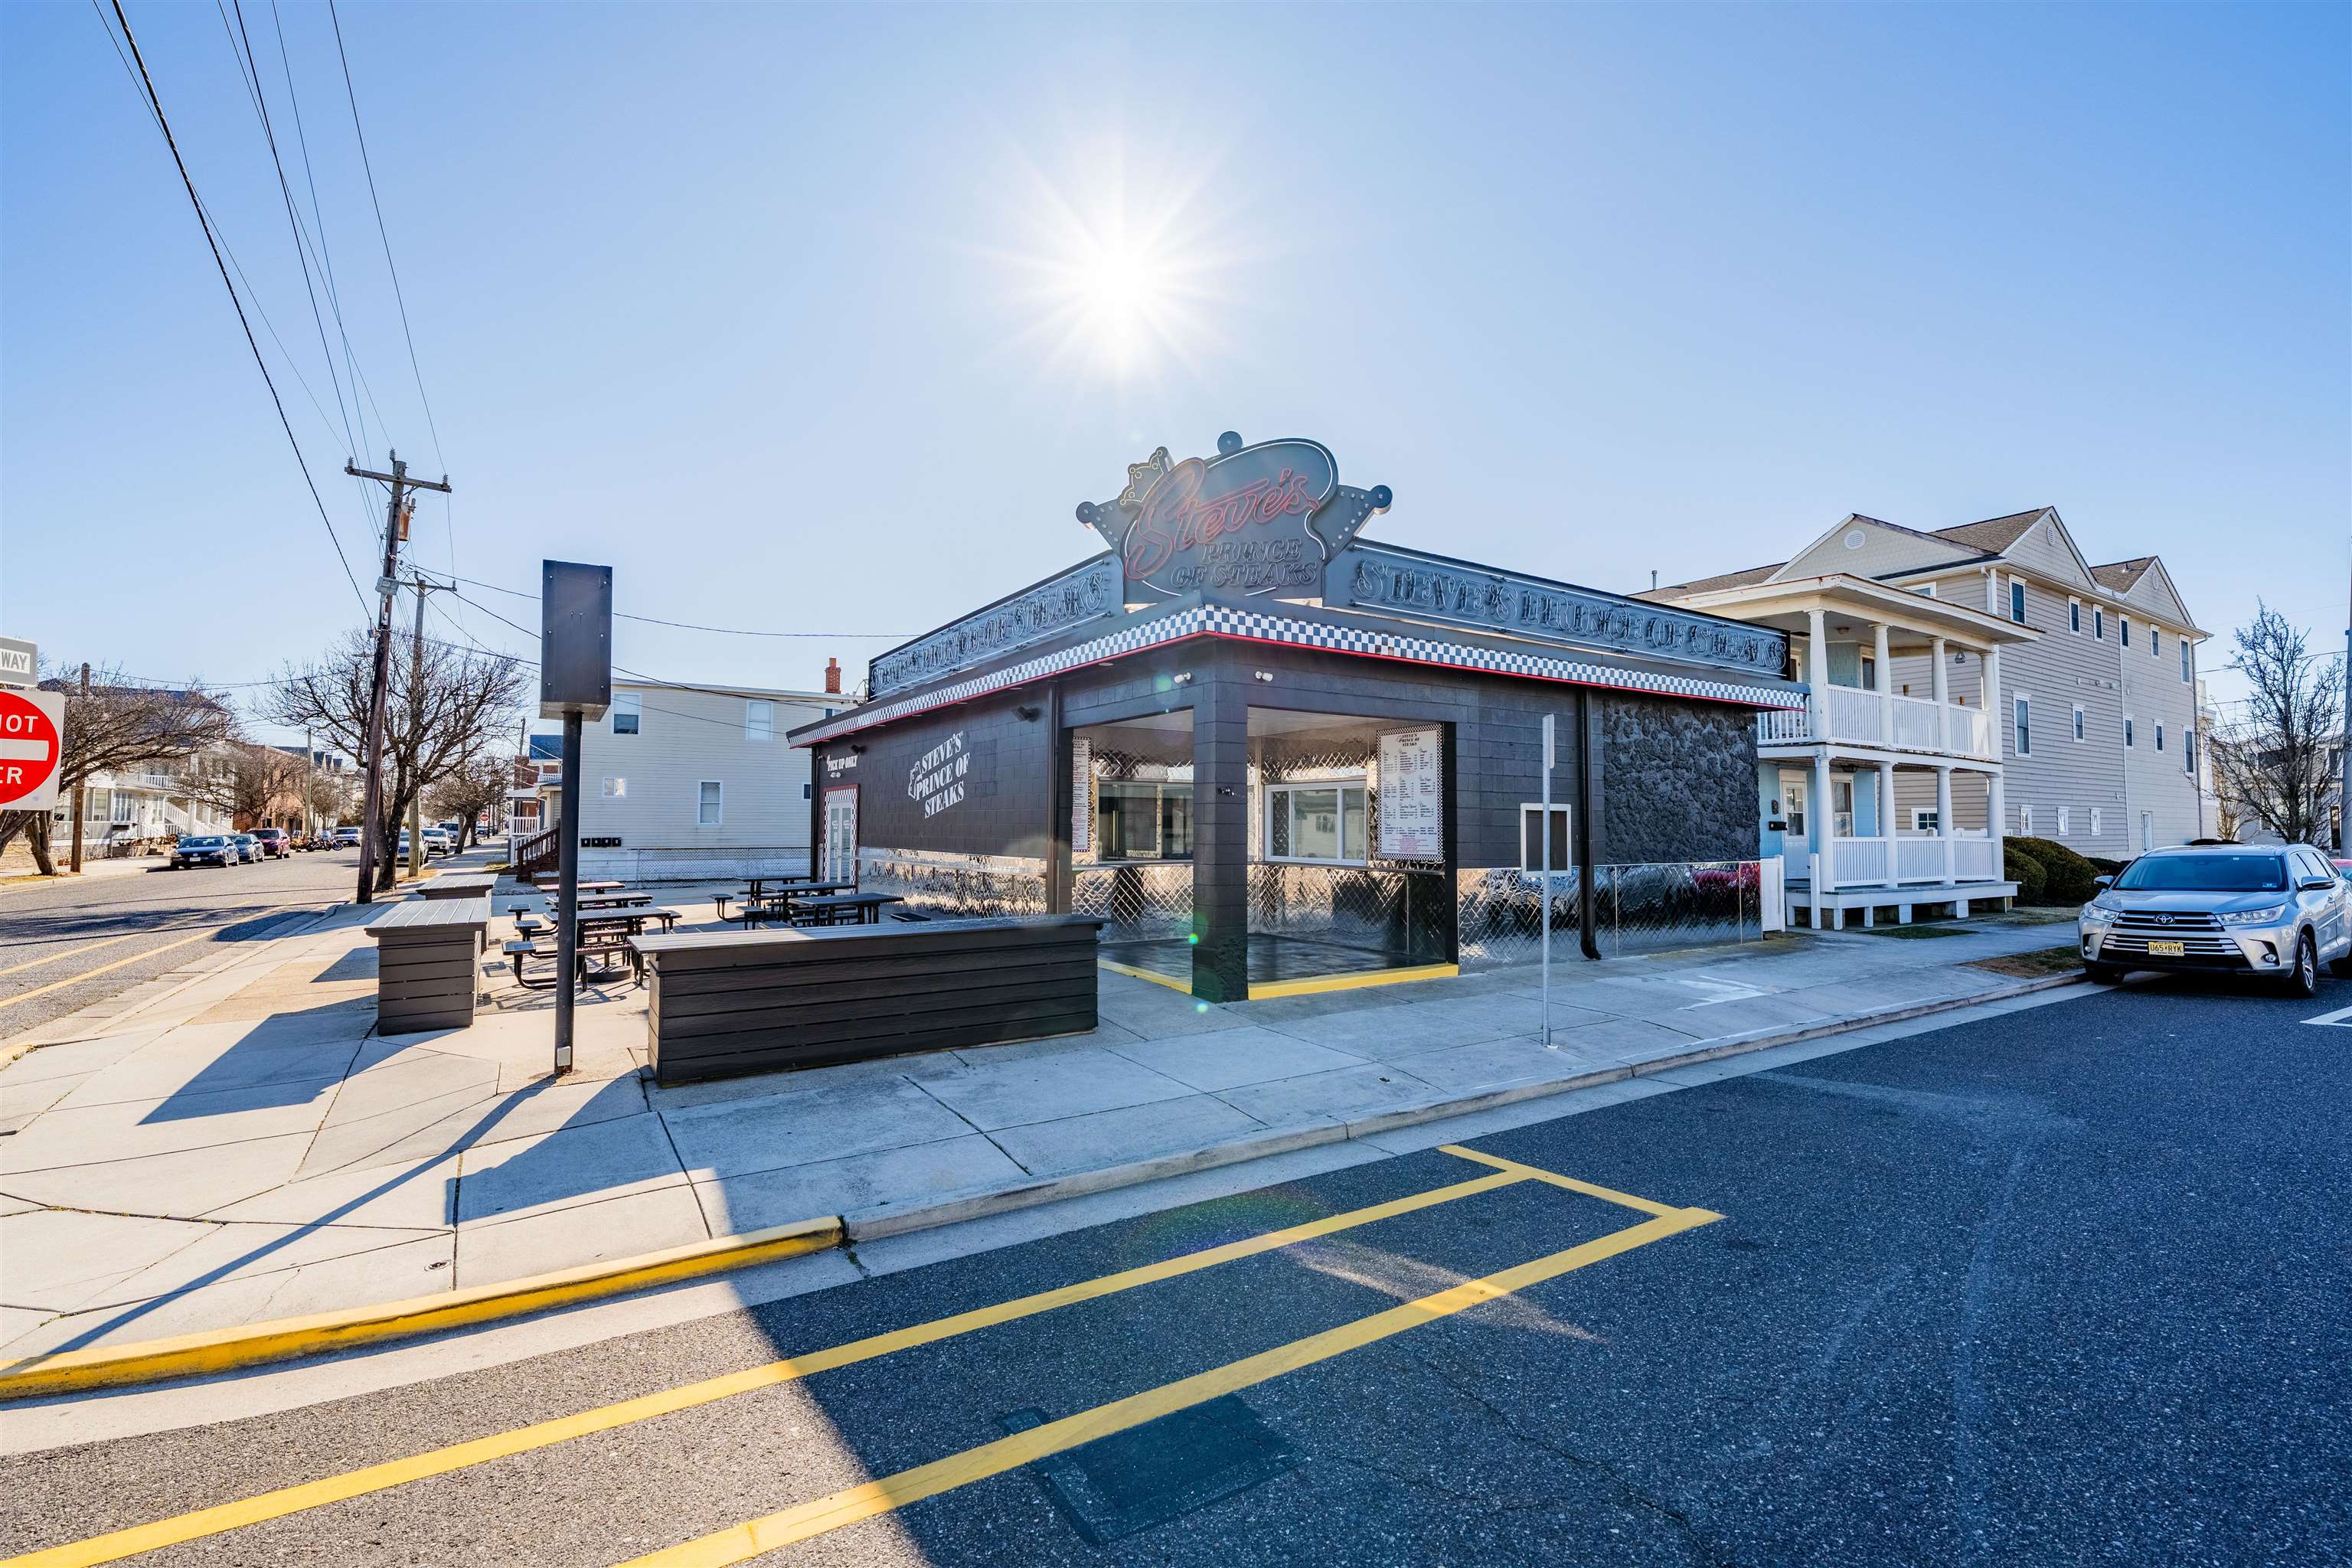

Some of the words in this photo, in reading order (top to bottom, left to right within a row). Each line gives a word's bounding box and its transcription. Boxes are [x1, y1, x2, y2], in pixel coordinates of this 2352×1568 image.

[1125, 458, 1321, 580] Steve's
[1200, 538, 1302, 564] PRINCE
[1170, 565, 1208, 589] OF
[1210, 562, 1318, 589] STEAKS
[1011, 569, 1103, 638] STEAKS
[1357, 558, 1518, 622] STEVE'S
[1524, 589, 1645, 645] PRINCE
[1650, 617, 1687, 651] OF
[1691, 624, 1786, 670] STEAKS
[2, 652, 28, 671] WAY
[0, 714, 38, 733] OT
[922, 731, 963, 774] STEVE'S
[916, 763, 954, 802] PRINCE
[956, 752, 970, 778] OF
[925, 780, 965, 819] STEAKS
